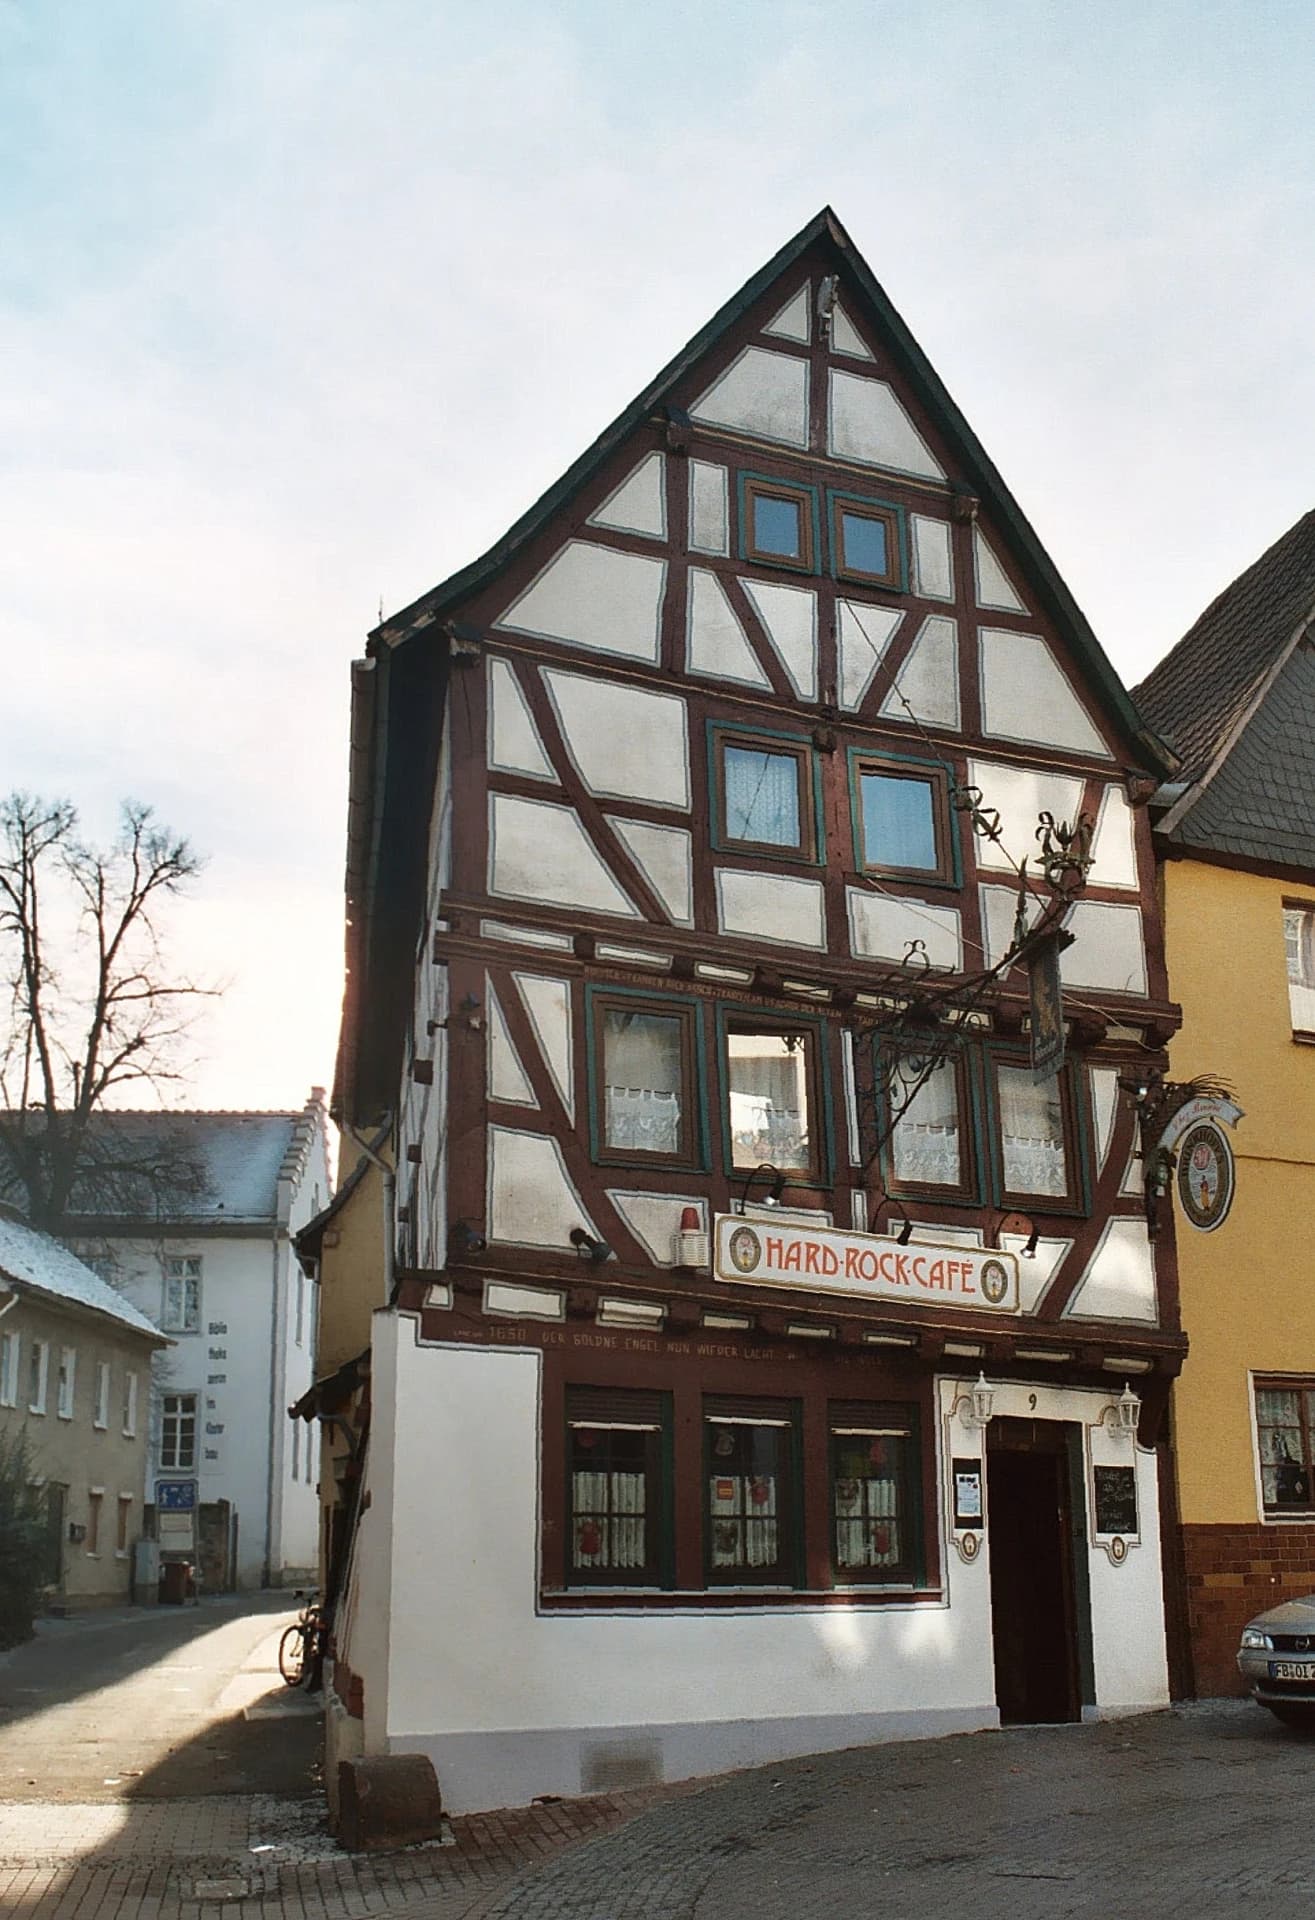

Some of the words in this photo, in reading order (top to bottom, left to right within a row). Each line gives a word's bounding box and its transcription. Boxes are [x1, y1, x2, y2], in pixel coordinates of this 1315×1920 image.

[765, 1236, 839, 1276] HARD
[844, 1247, 910, 1286] ROCK
[1028, 1393, 1037, 1411] 9
